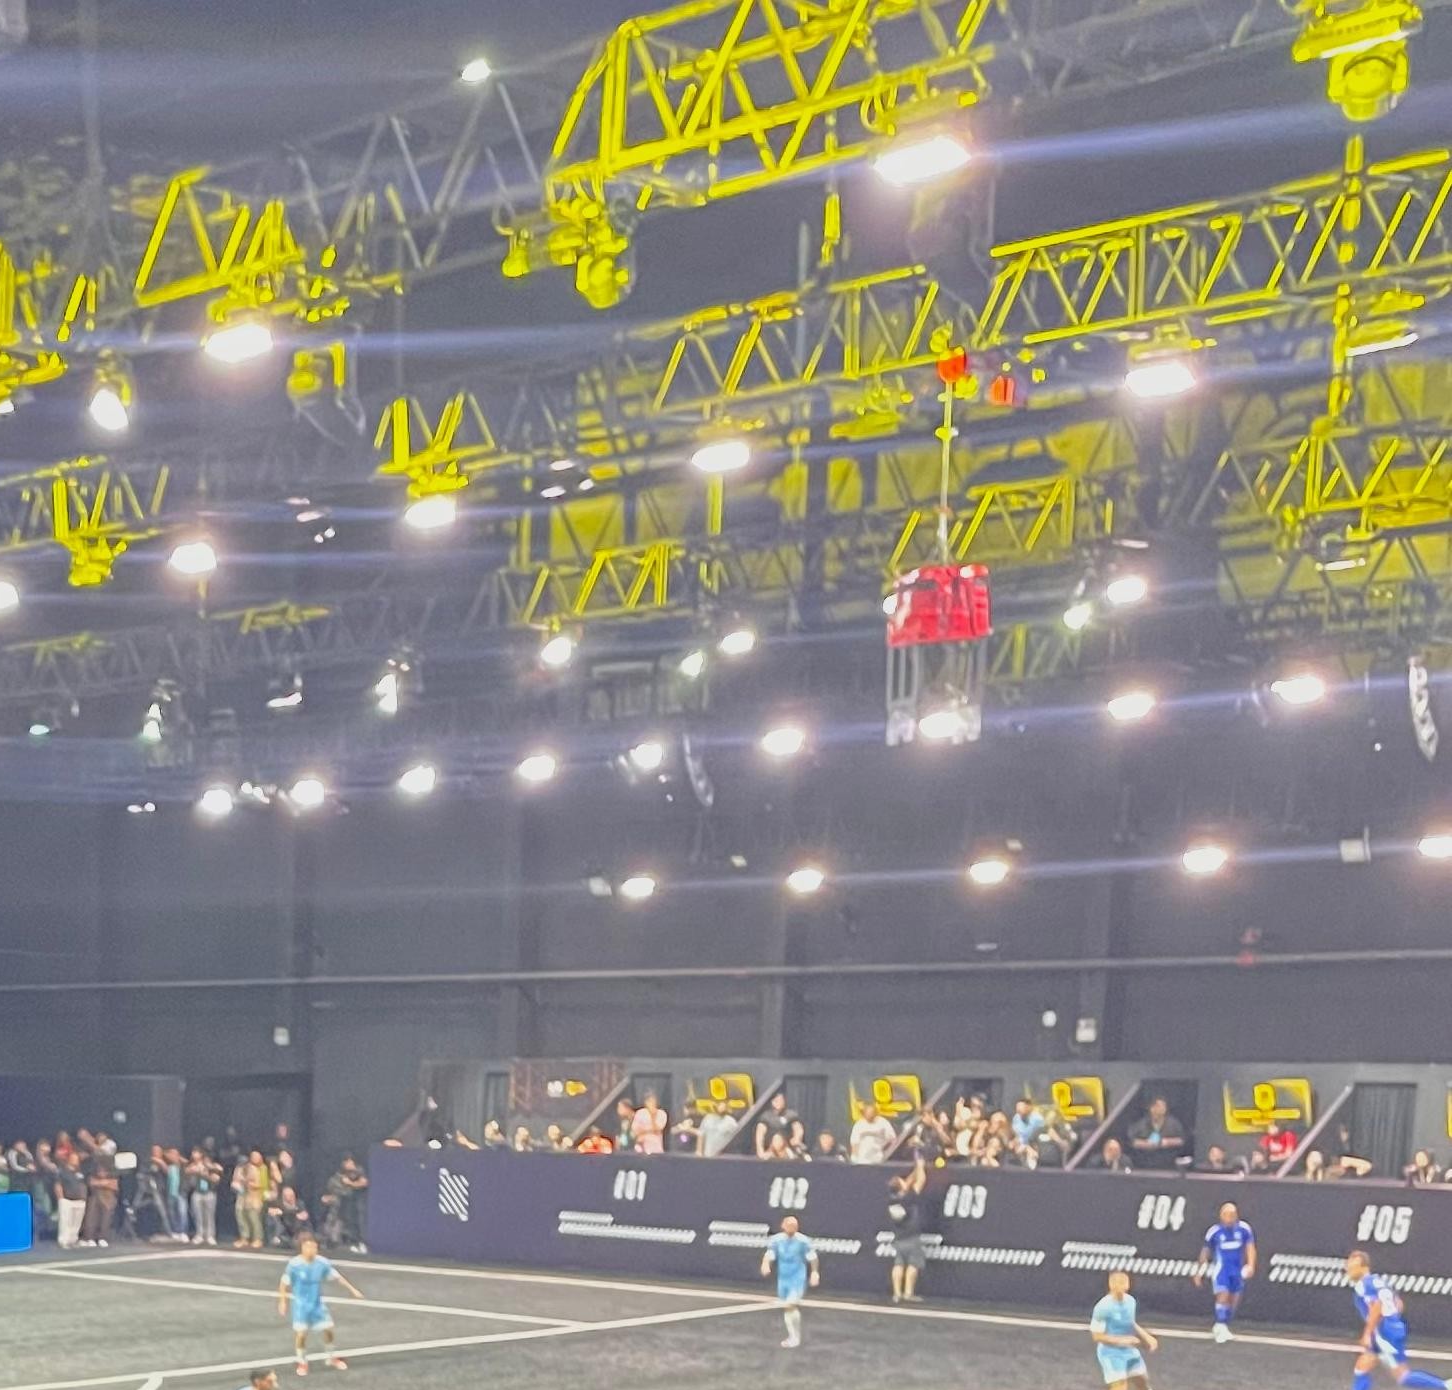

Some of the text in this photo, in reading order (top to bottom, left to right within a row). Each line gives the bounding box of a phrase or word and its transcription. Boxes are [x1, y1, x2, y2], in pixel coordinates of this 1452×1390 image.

[768, 1176, 809, 1210] #02
[944, 1184, 987, 1219] #03
[1137, 1194, 1186, 1231] #04
[1357, 1205, 1413, 1244] #05
